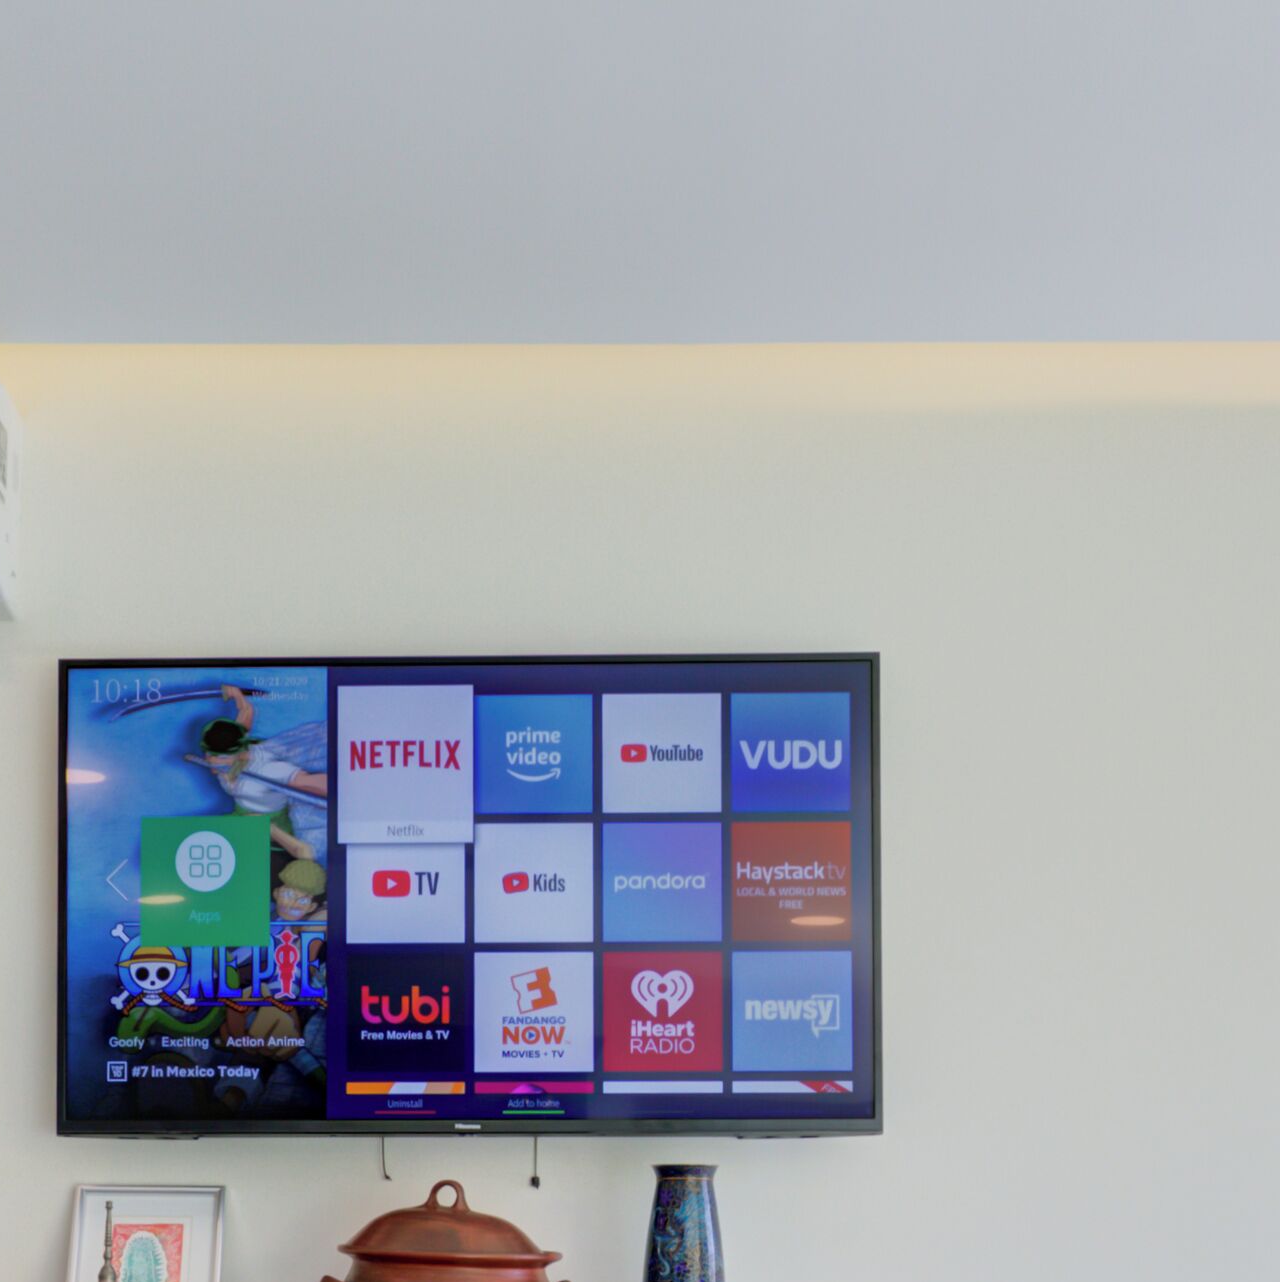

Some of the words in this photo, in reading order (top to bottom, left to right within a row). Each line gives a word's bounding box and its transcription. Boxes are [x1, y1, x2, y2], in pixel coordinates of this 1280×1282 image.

[91, 678, 162, 703] 10:18
[505, 728, 561, 748] prime
[349, 740, 461, 771] NETFLIX
[506, 748, 561, 765] video
[649, 744, 703, 762] YouTube
[739, 739, 842, 770] VUDU
[386, 825, 424, 837] Netflix
[736, 861, 825, 883] Haystack
[827, 863, 846, 880] tv
[414, 871, 440, 896] TV
[532, 873, 566, 893] Kids
[614, 872, 706, 893] pandora
[736, 887, 766, 896] LOCAL
[778, 887, 814, 896] WORLD
[816, 887, 847, 896] NEWS
[778, 900, 803, 909] FREE
[188, 910, 221, 922] Apps
[361, 985, 450, 1024] tubi
[744, 998, 833, 1025] newsy
[502, 1016, 566, 1025] FANDANGO
[630, 1019, 695, 1037] iHeart
[108, 1036, 144, 1050] Goofy
[161, 1036, 209, 1050] Exciting
[226, 1036, 265, 1047] Action
[267, 1036, 305, 1047] Anime
[360, 1030, 385, 1040] Free
[386, 1030, 423, 1040] Movies
[425, 1030, 433, 1040] &
[435, 1030, 450, 1040] TV
[502, 1026, 565, 1045] NOW
[502, 1050, 540, 1058] MOVIES
[551, 1050, 565, 1058] TV
[630, 1038, 695, 1054] RADIO
[131, 1065, 148, 1077] #7
[151, 1065, 163, 1077] in
[166, 1065, 215, 1077] Mexico
[218, 1065, 260, 1080] Today
[387, 1099, 423, 1108] Uninstall
[508, 1098, 525, 1108] Add
[526, 1098, 535, 1108] to
[537, 1098, 560, 1108] home
